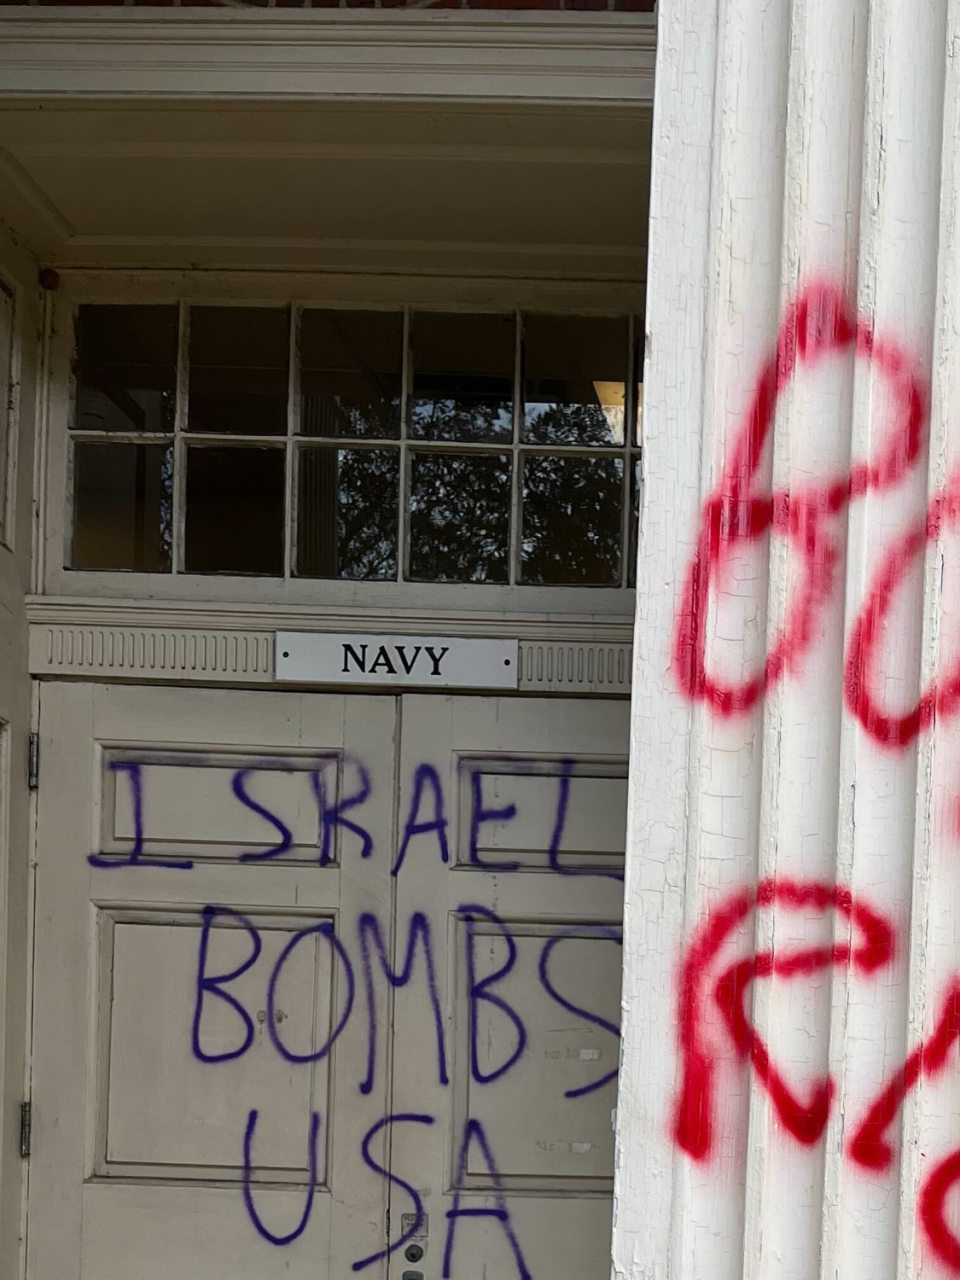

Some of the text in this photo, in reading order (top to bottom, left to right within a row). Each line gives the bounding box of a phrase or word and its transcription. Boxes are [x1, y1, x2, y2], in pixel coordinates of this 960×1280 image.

[341, 643, 449, 676] NAVY
[87, 752, 625, 880] ISRAEL
[191, 904, 623, 1098] BOMBS
